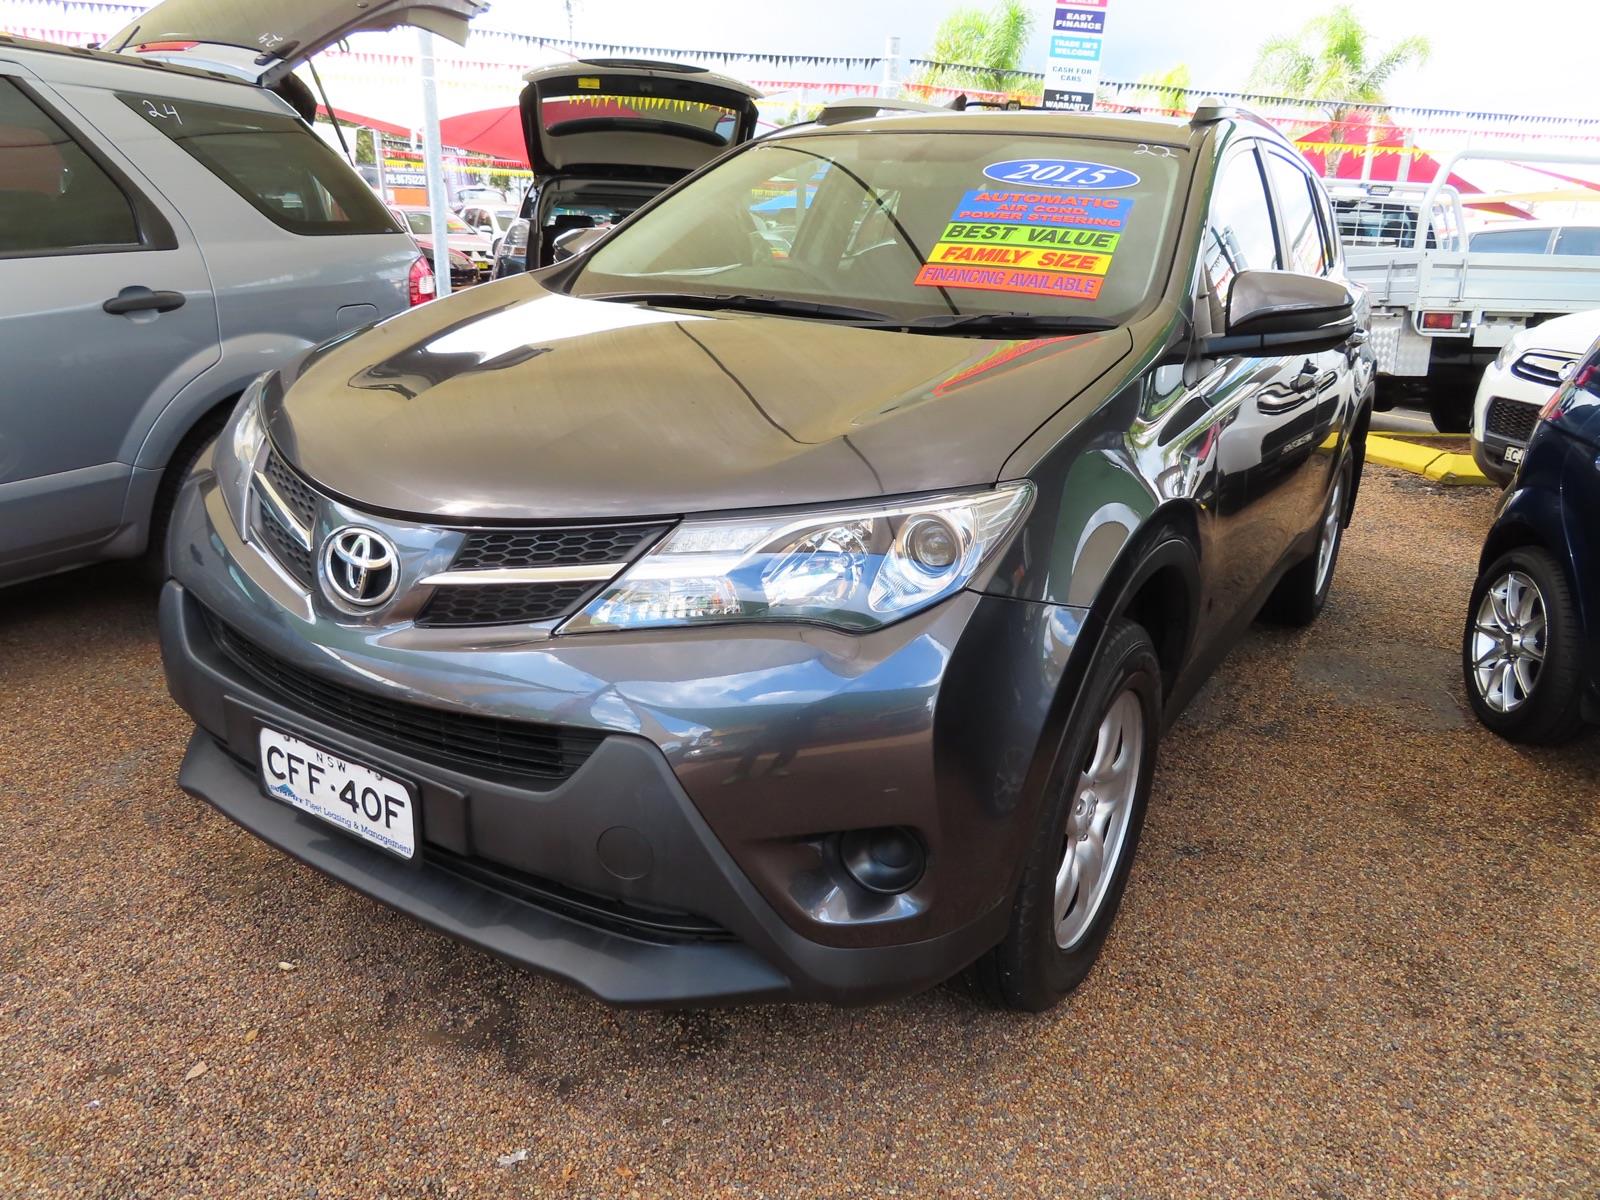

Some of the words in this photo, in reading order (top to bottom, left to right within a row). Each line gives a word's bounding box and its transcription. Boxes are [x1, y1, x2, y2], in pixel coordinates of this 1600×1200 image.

[1055, 20, 1102, 30] FINANCE
[1066, 13, 1093, 21] EASY
[1055, 39, 1080, 48] TRADE
[1055, 47, 1096, 57] WELCOME
[1060, 74, 1082, 82] CARS
[142, 99, 183, 125] 24
[1045, 100, 1090, 111] WARRANTY
[1003, 163, 1118, 185] 2015
[975, 192, 1120, 209] AUTOMATIC
[996, 204, 1028, 212] AIR
[1033, 206, 1088, 215] COND.
[959, 211, 1022, 220] POWER
[1027, 214, 1121, 227] STEERING
[945, 225, 1018, 240] BEST
[1028, 228, 1114, 248] VALUE
[940, 246, 1034, 264] FAMILY
[1038, 253, 1099, 270] SIZE
[922, 267, 1005, 285] FINANCING
[1007, 273, 1096, 294] AVAILABLE
[316, 752, 346, 773] NSW
[305, 798, 322, 812] Fleet
[323, 807, 352, 828] Leasing
[353, 821, 360, 831] &
[360, 823, 412, 856] Management
